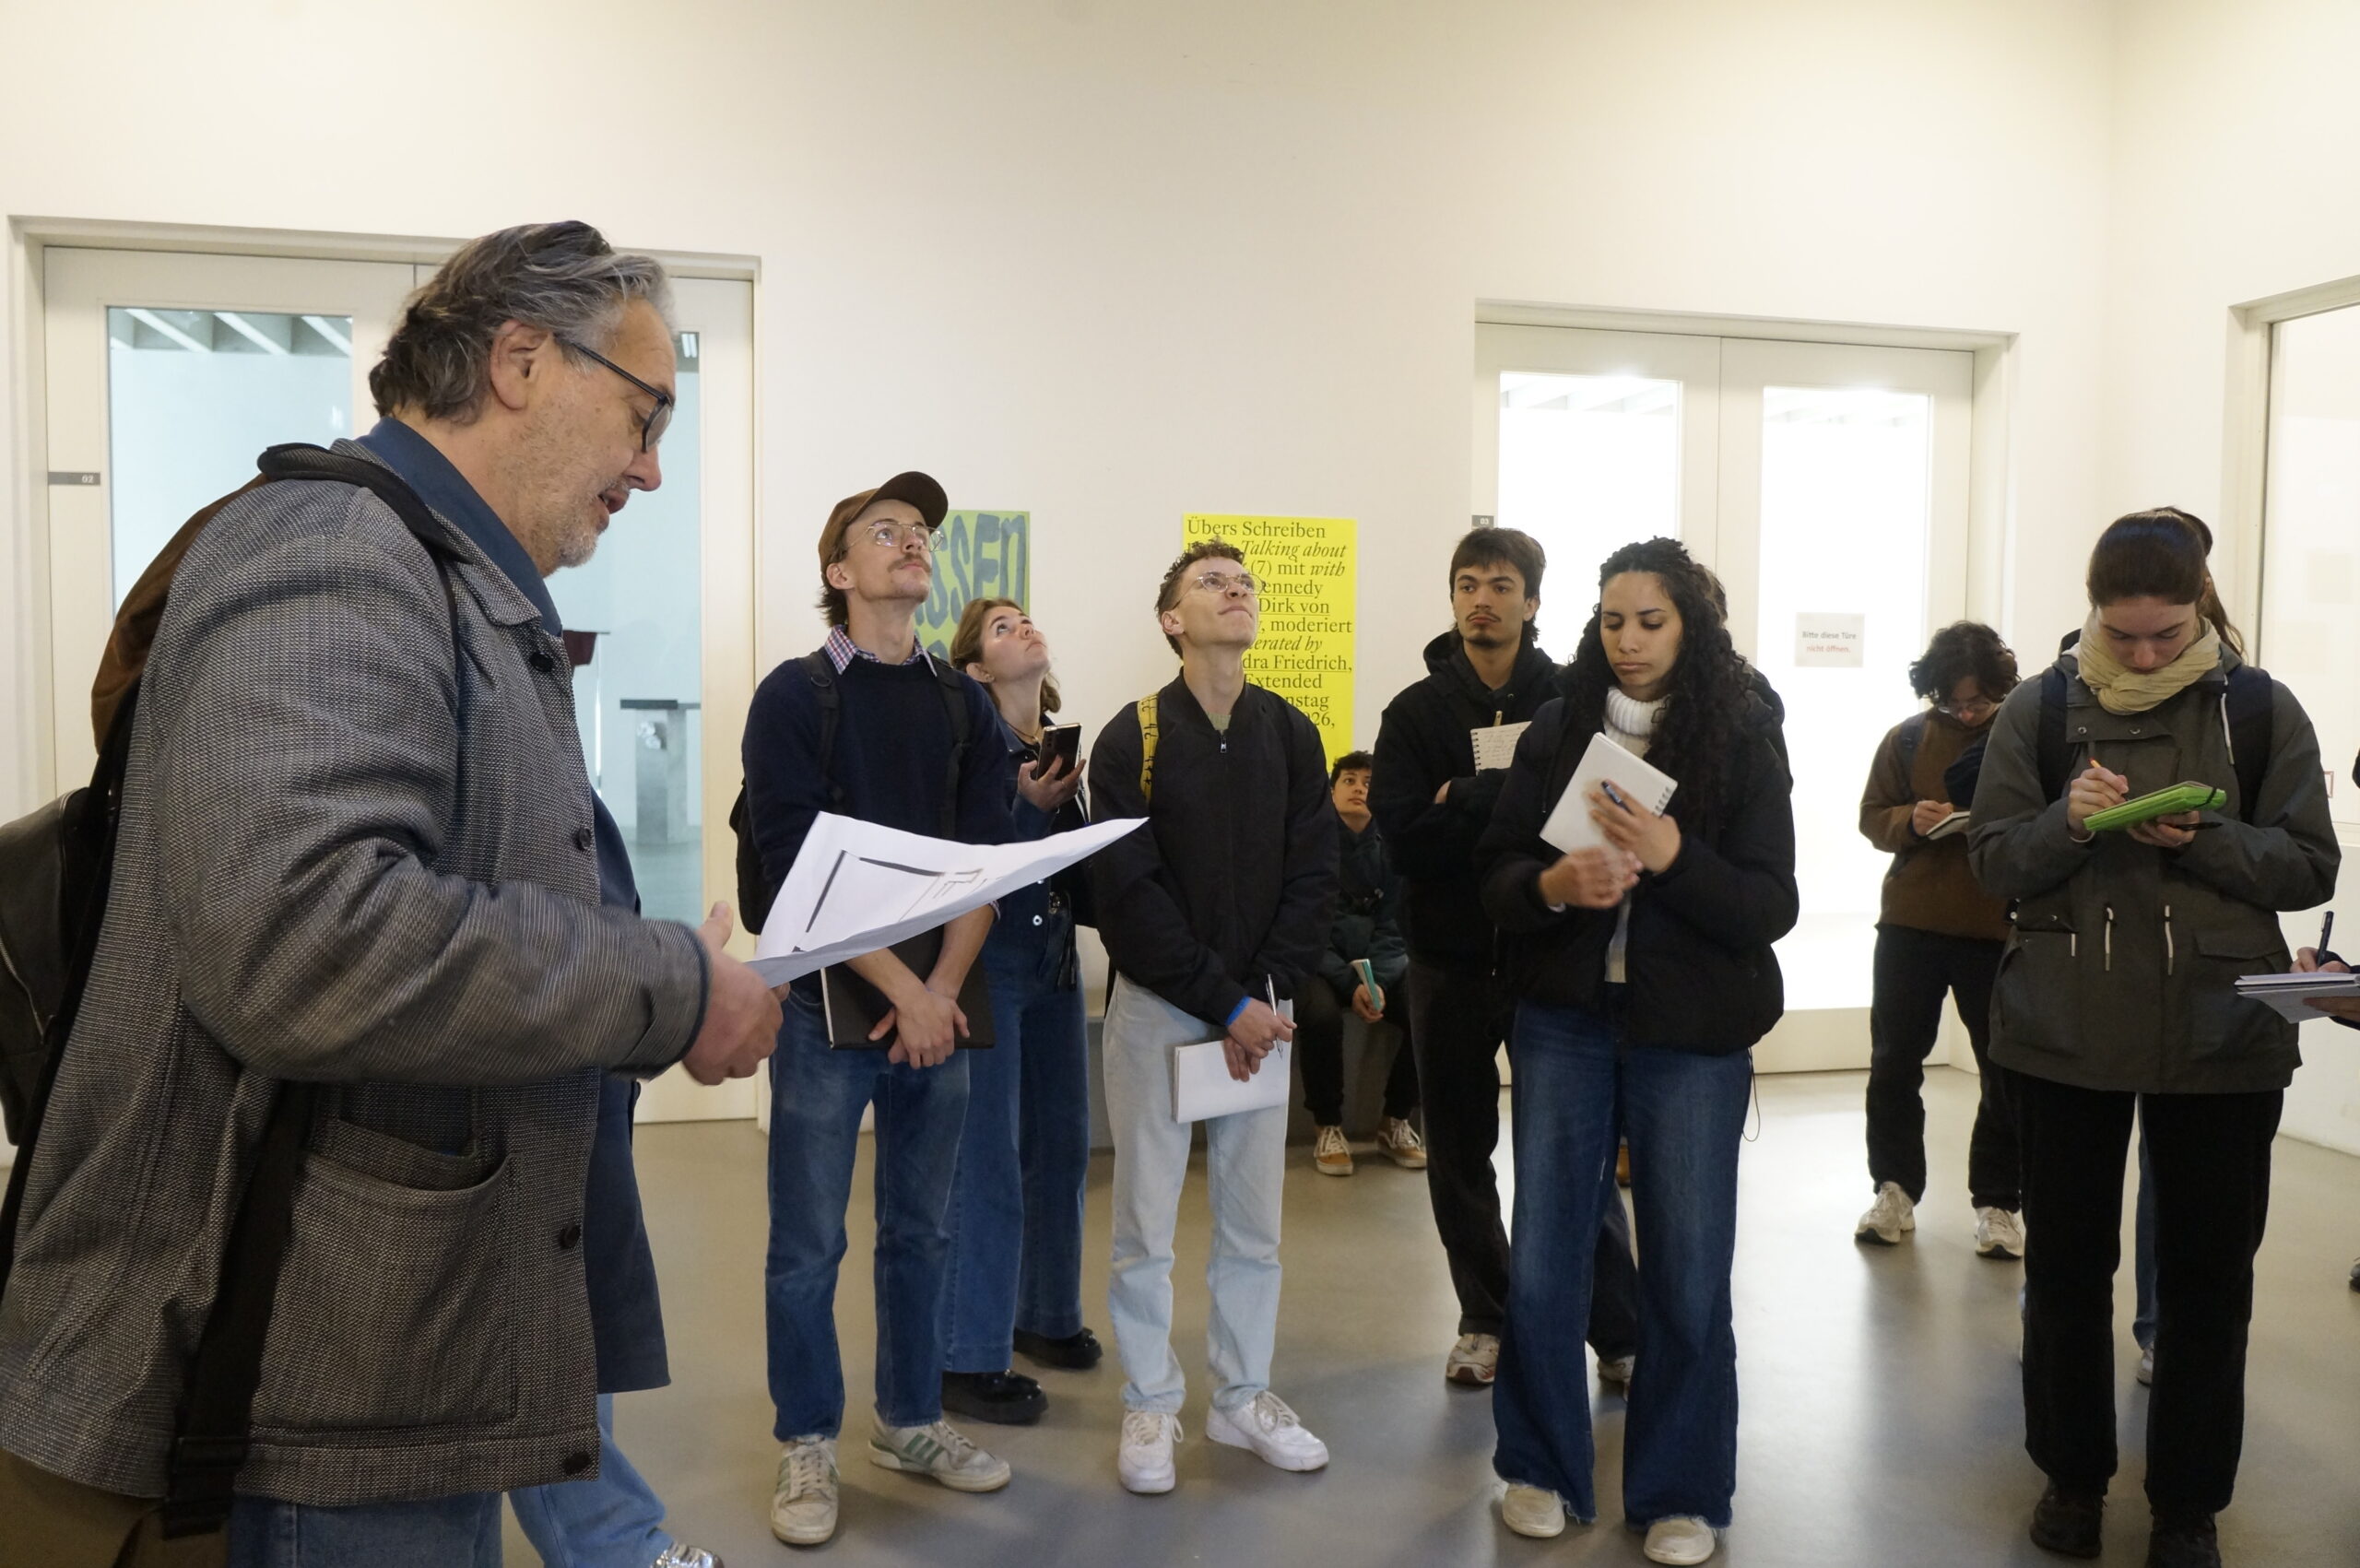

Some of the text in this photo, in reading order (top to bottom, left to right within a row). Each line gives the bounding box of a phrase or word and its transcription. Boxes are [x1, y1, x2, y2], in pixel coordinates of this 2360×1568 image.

[81, 474, 94, 484] 02
[1187, 516, 1326, 538] Übers Schreiben
[1242, 540, 1301, 562] Talking
[1303, 542, 1347, 558] about
[1250, 560, 1272, 576] (7)
[1277, 561, 1306, 576] mit
[1310, 563, 1346, 578] with
[1261, 579, 1324, 599] ennedy
[1258, 597, 1330, 614] Dirk von
[1270, 617, 1352, 633] moderiert
[1248, 636, 1323, 654] erated by
[1242, 654, 1352, 672] dra Friedrich,
[1285, 695, 1330, 712] nstag
